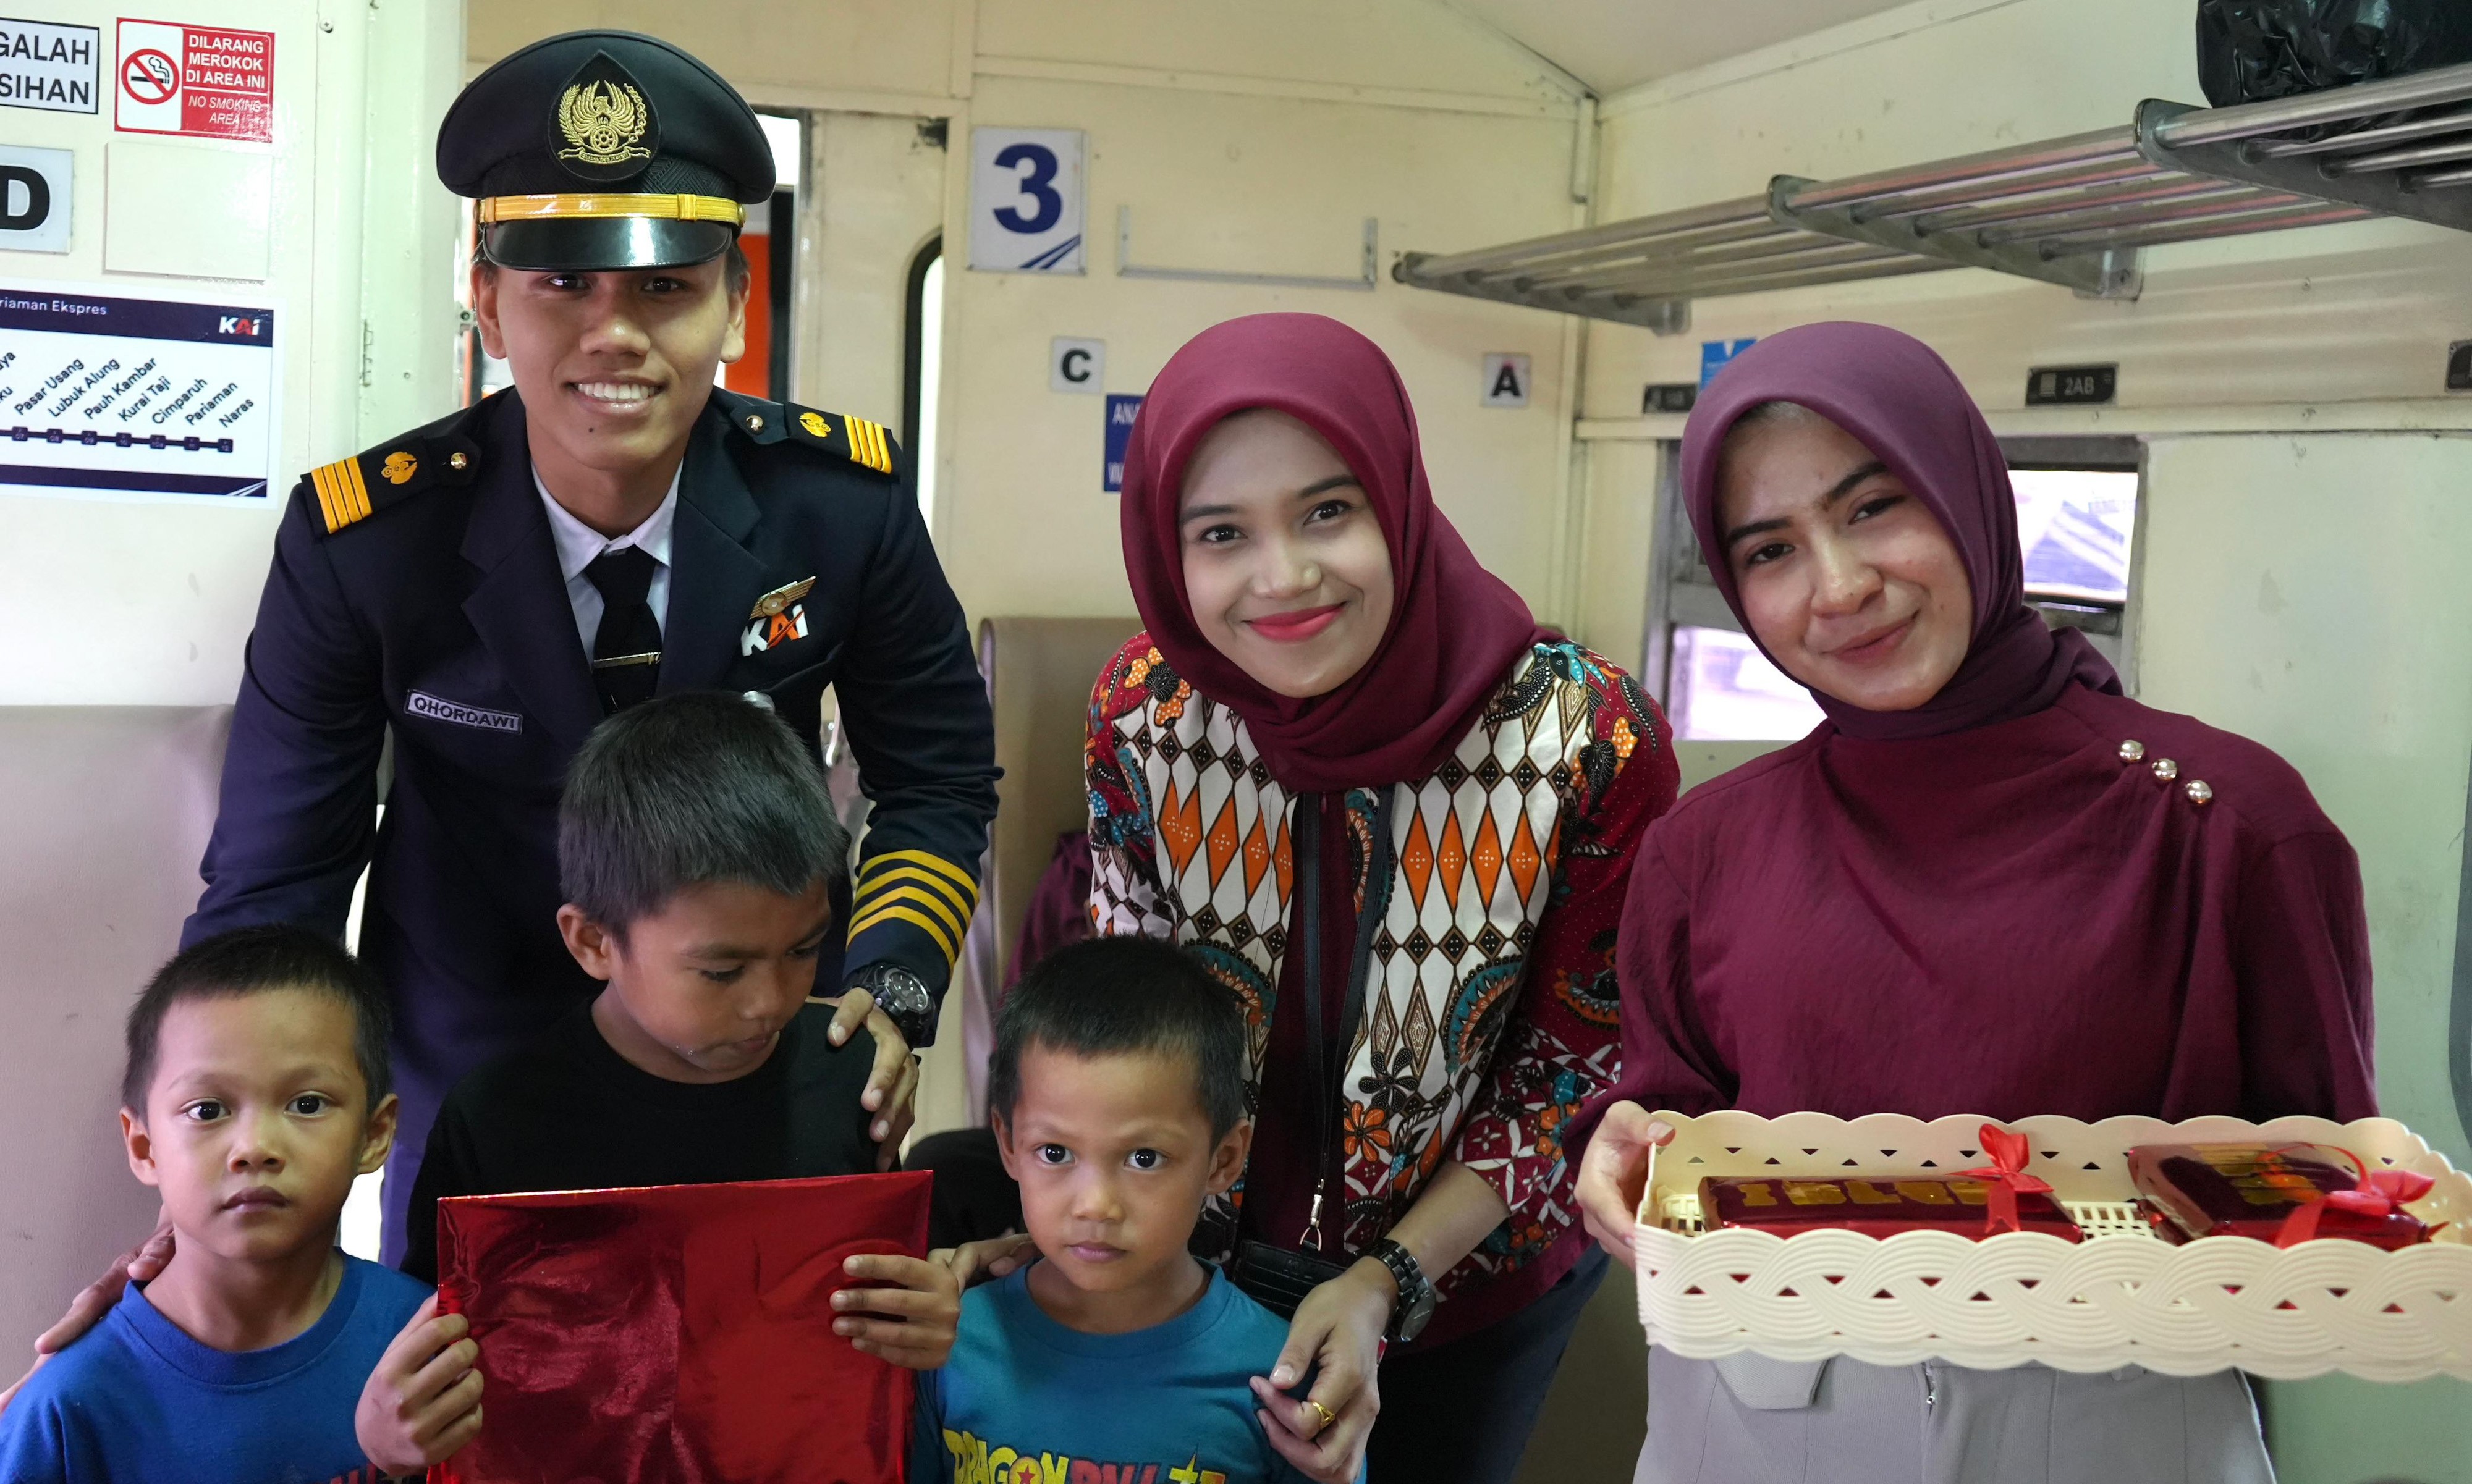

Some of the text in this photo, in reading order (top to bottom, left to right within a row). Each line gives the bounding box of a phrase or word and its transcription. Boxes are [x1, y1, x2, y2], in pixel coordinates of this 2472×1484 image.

[188, 35, 264, 54] DILARANG
[188, 52, 263, 71] MEROKOK
[186, 69, 265, 88] DI AREA INI
[188, 95, 262, 112] NO SMOKING
[209, 112, 240, 125] AREA
[0, 165, 51, 230] D
[993, 143, 1064, 234] 3
[52, 300, 107, 316] Ekspres
[1061, 348, 1092, 382] C
[1491, 361, 1522, 397] A
[14, 359, 85, 415] Pasar Usang
[48, 359, 121, 417] Lubuk Alung
[83, 358, 157, 419] Pauh Kambar
[118, 376, 172, 421] Kurai Taji
[152, 377, 208, 424] Cimparuh
[185, 382, 239, 426] Pariaman
[219, 398, 255, 428] Naras
[741, 604, 808, 657] KAI
[414, 696, 515, 729] QHORDAWI
